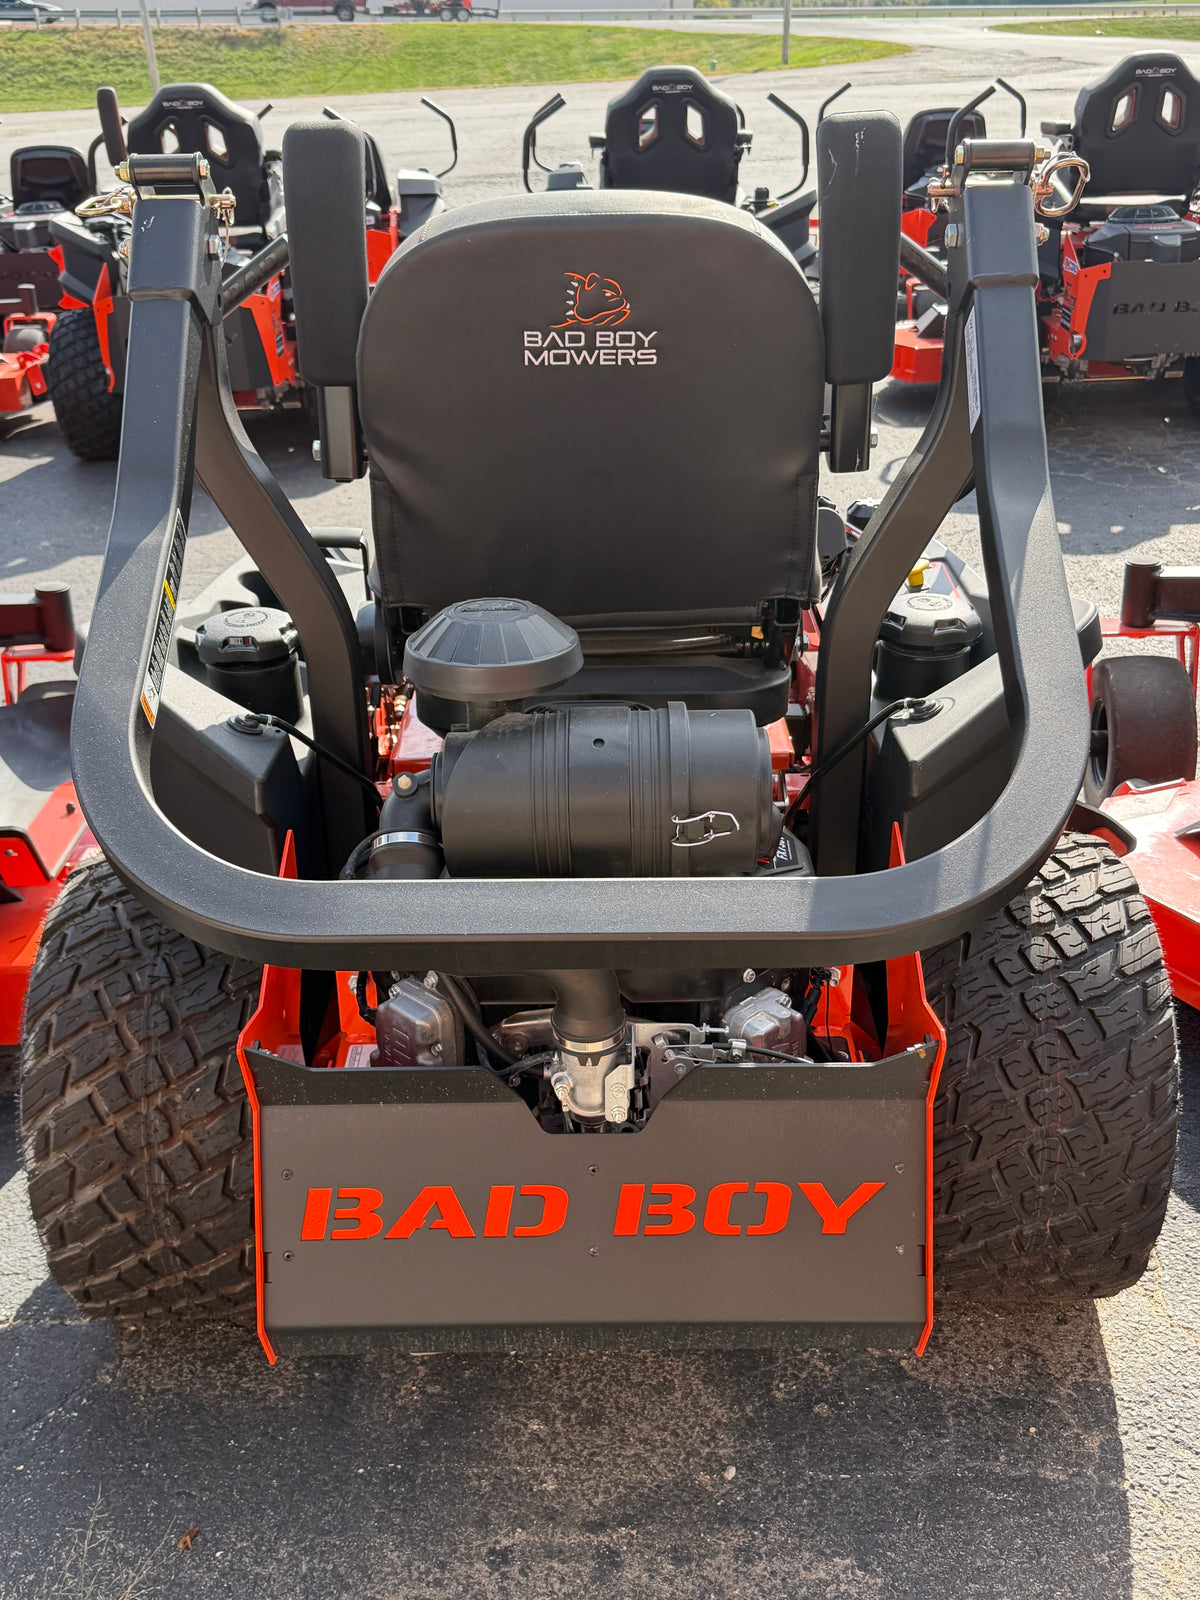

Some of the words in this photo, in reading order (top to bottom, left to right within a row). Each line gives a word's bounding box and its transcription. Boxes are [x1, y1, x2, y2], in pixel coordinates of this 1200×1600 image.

[524, 331, 585, 347] BAD
[595, 331, 658, 347] BOY
[524, 349, 657, 365] MOWERS
[300, 1184, 569, 1240] BAD
[613, 1182, 886, 1236] BOY
